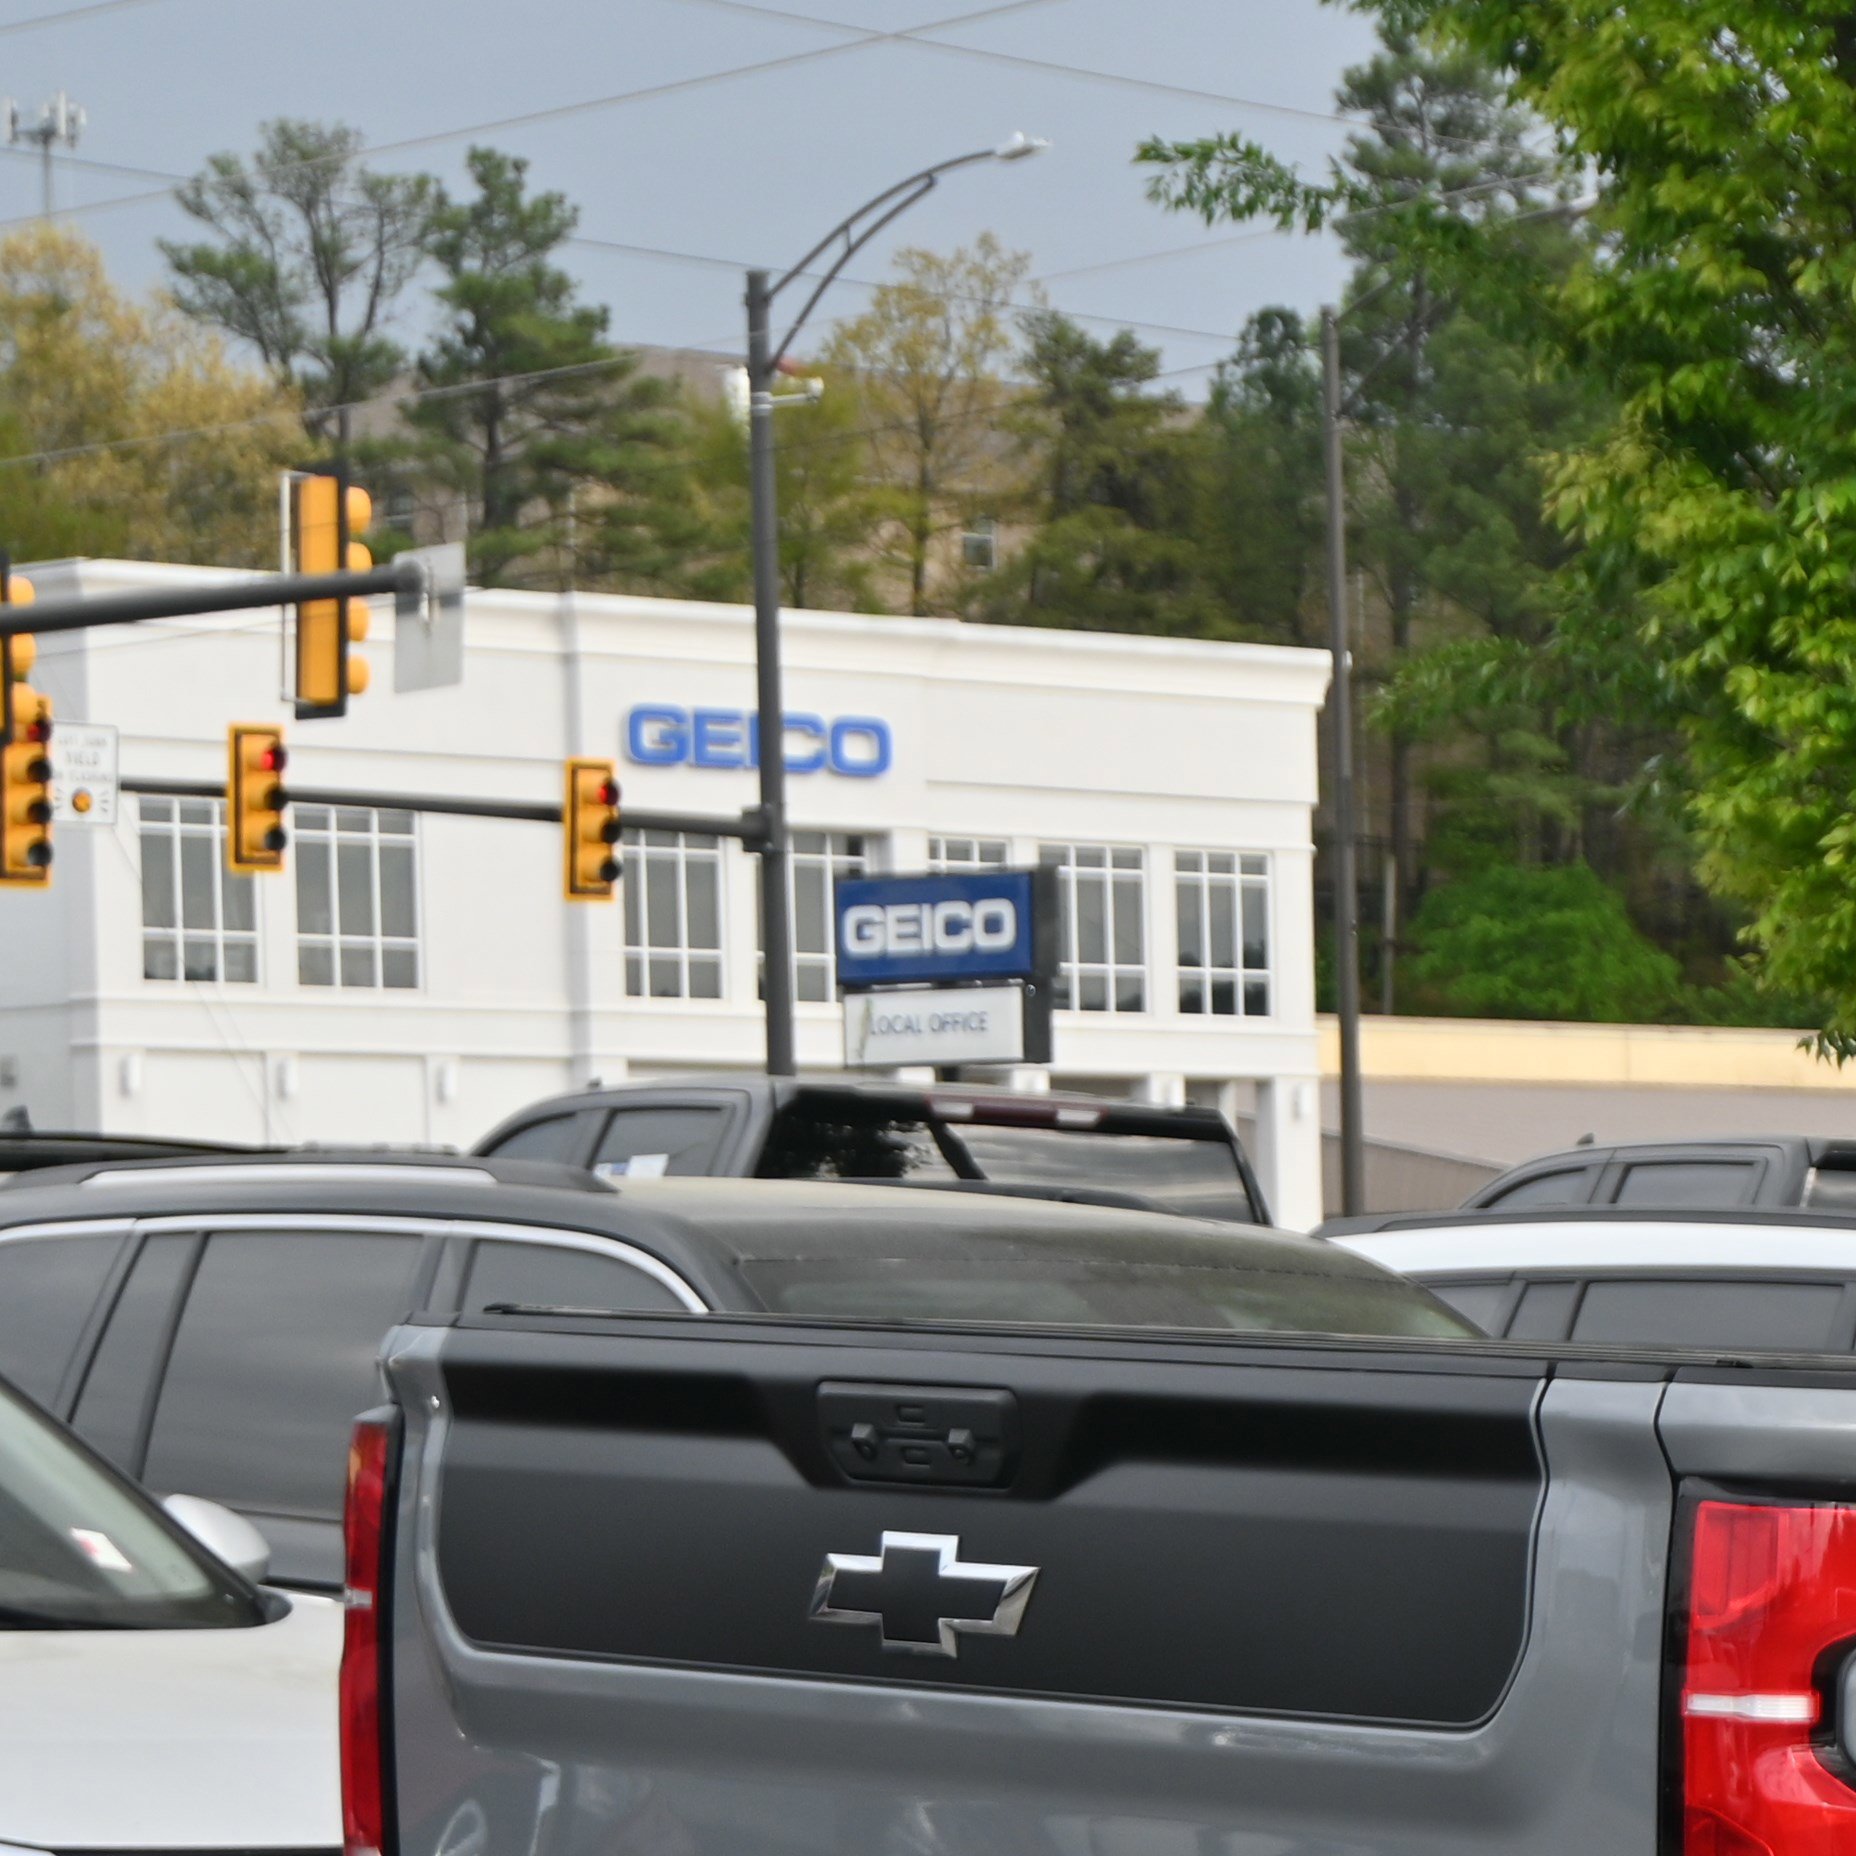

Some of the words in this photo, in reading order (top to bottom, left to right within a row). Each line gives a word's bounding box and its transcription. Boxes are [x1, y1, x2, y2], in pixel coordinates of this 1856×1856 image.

[627, 703, 892, 777] GEICO
[842, 898, 1017, 958] GEICO
[869, 1013, 922, 1035] LOCAL
[929, 1010, 989, 1033] OFFICE
